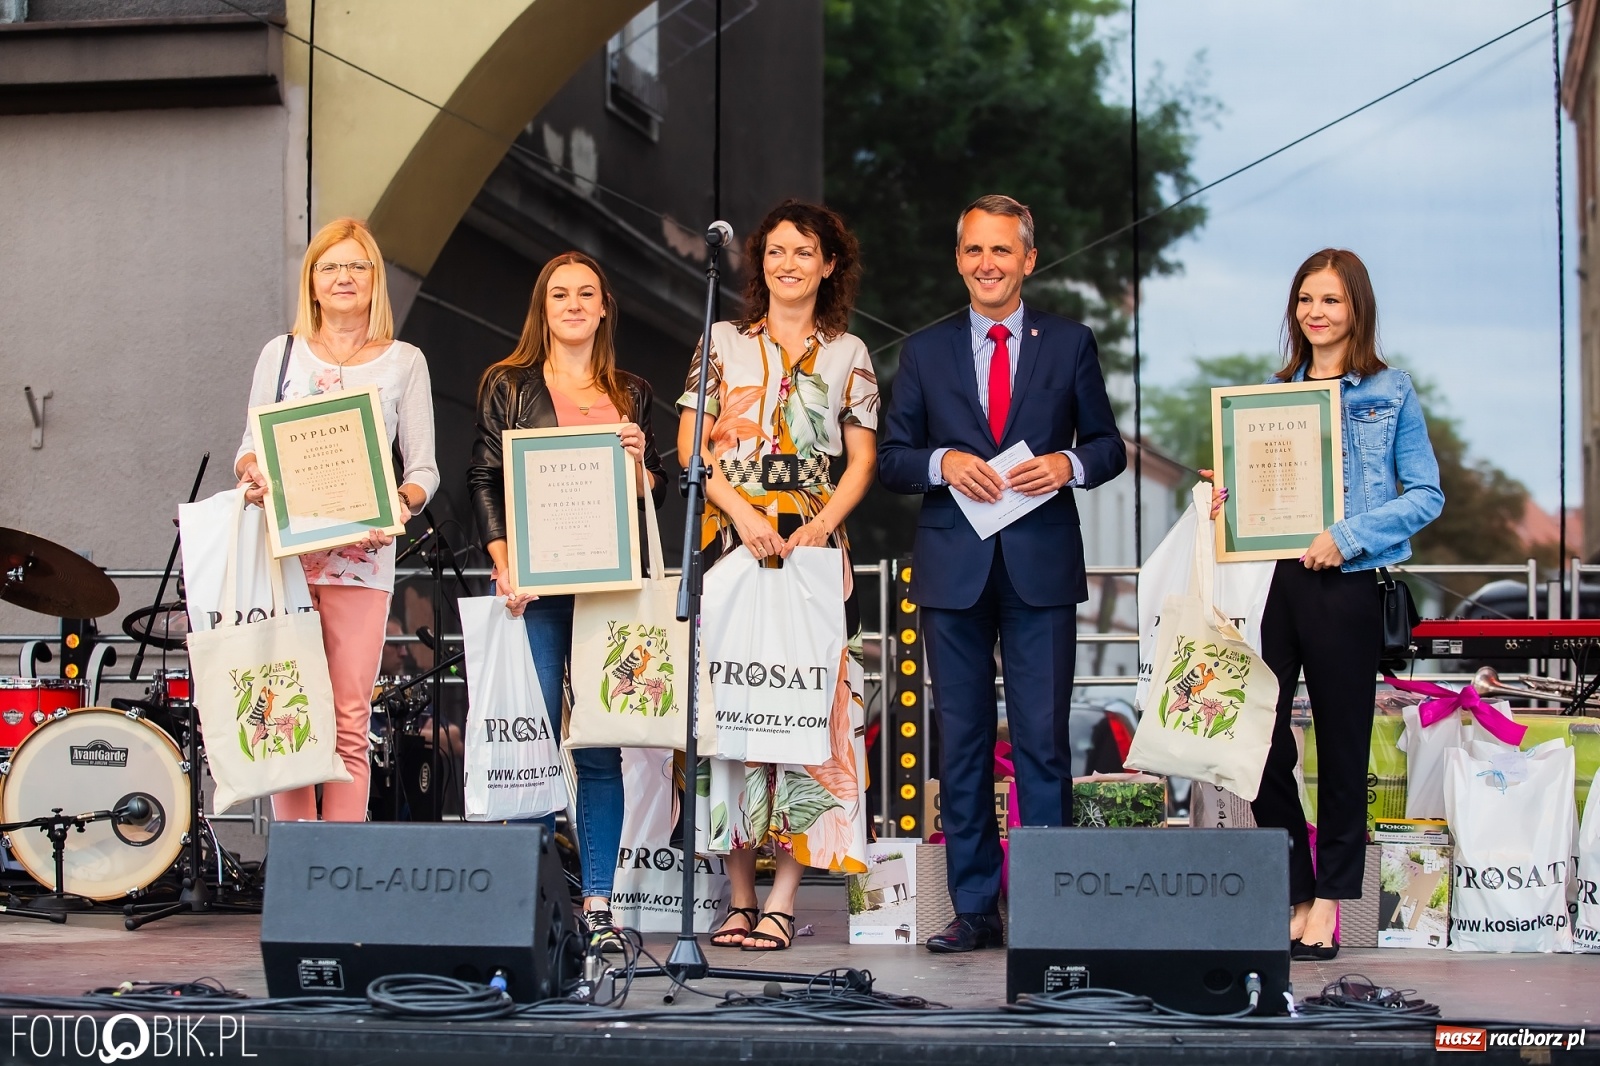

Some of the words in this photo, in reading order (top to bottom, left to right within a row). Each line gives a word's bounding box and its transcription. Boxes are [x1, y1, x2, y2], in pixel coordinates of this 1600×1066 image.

[290, 424, 350, 442] DYPLOM
[1248, 421, 1307, 433] DYPLOM
[539, 462, 600, 473] DYPLOM
[709, 660, 828, 690] PROSAT
[484, 716, 551, 742] PROSA
[715, 710, 828, 728] WW.KOTLY.COM
[72, 748, 126, 762] AvantGarde
[306, 865, 493, 893] POL-AUDIO
[1054, 871, 1245, 897] POL-AUDIO
[1455, 860, 1566, 890] PROSAT
